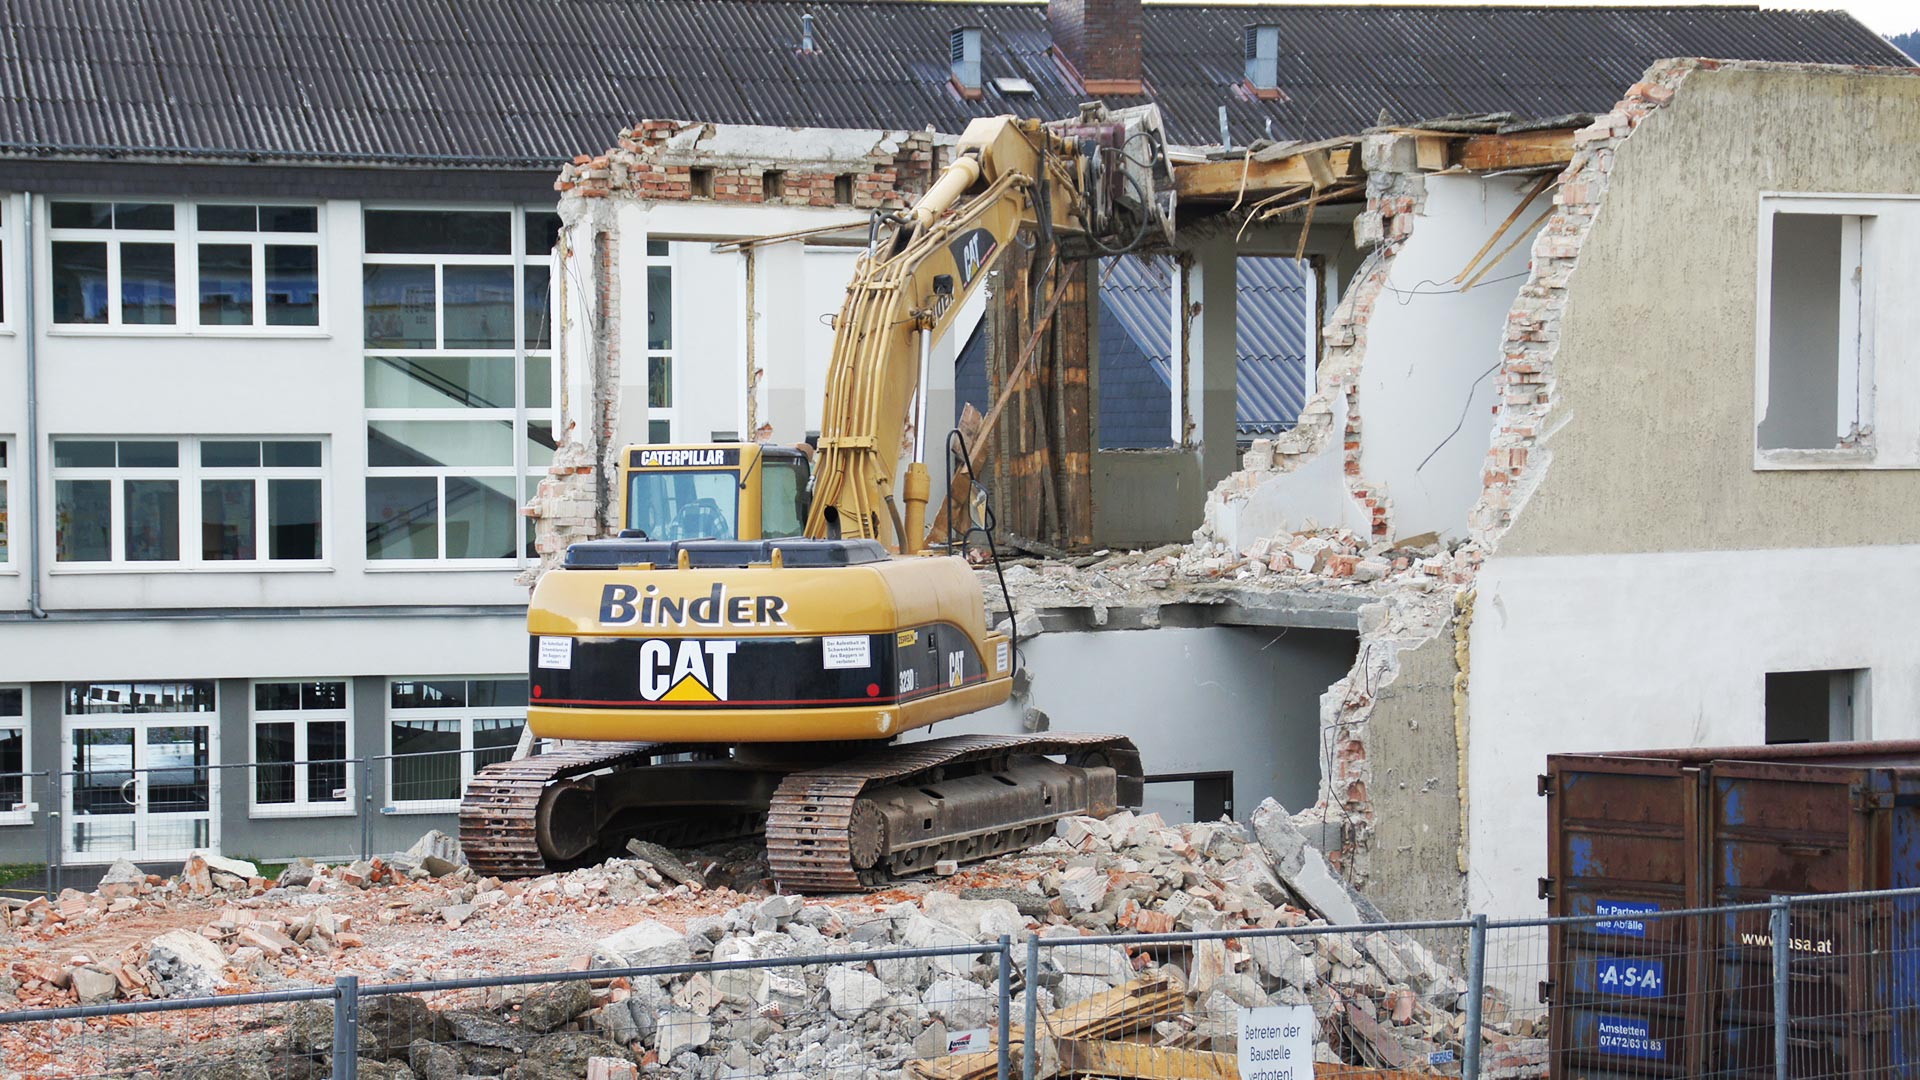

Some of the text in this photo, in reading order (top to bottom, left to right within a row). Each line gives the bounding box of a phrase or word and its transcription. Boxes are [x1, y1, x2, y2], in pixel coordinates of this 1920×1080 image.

[963, 231, 980, 282] CAT
[640, 450, 724, 466] CATERPILLAR
[639, 639, 737, 701] CAT
[949, 650, 964, 687] CAT
[1597, 905, 1609, 915] Ihr
[1245, 1022, 1301, 1040] Betreten der
[1599, 1022, 1646, 1037] Amstetten
[1250, 1044, 1291, 1062] Baustelle
